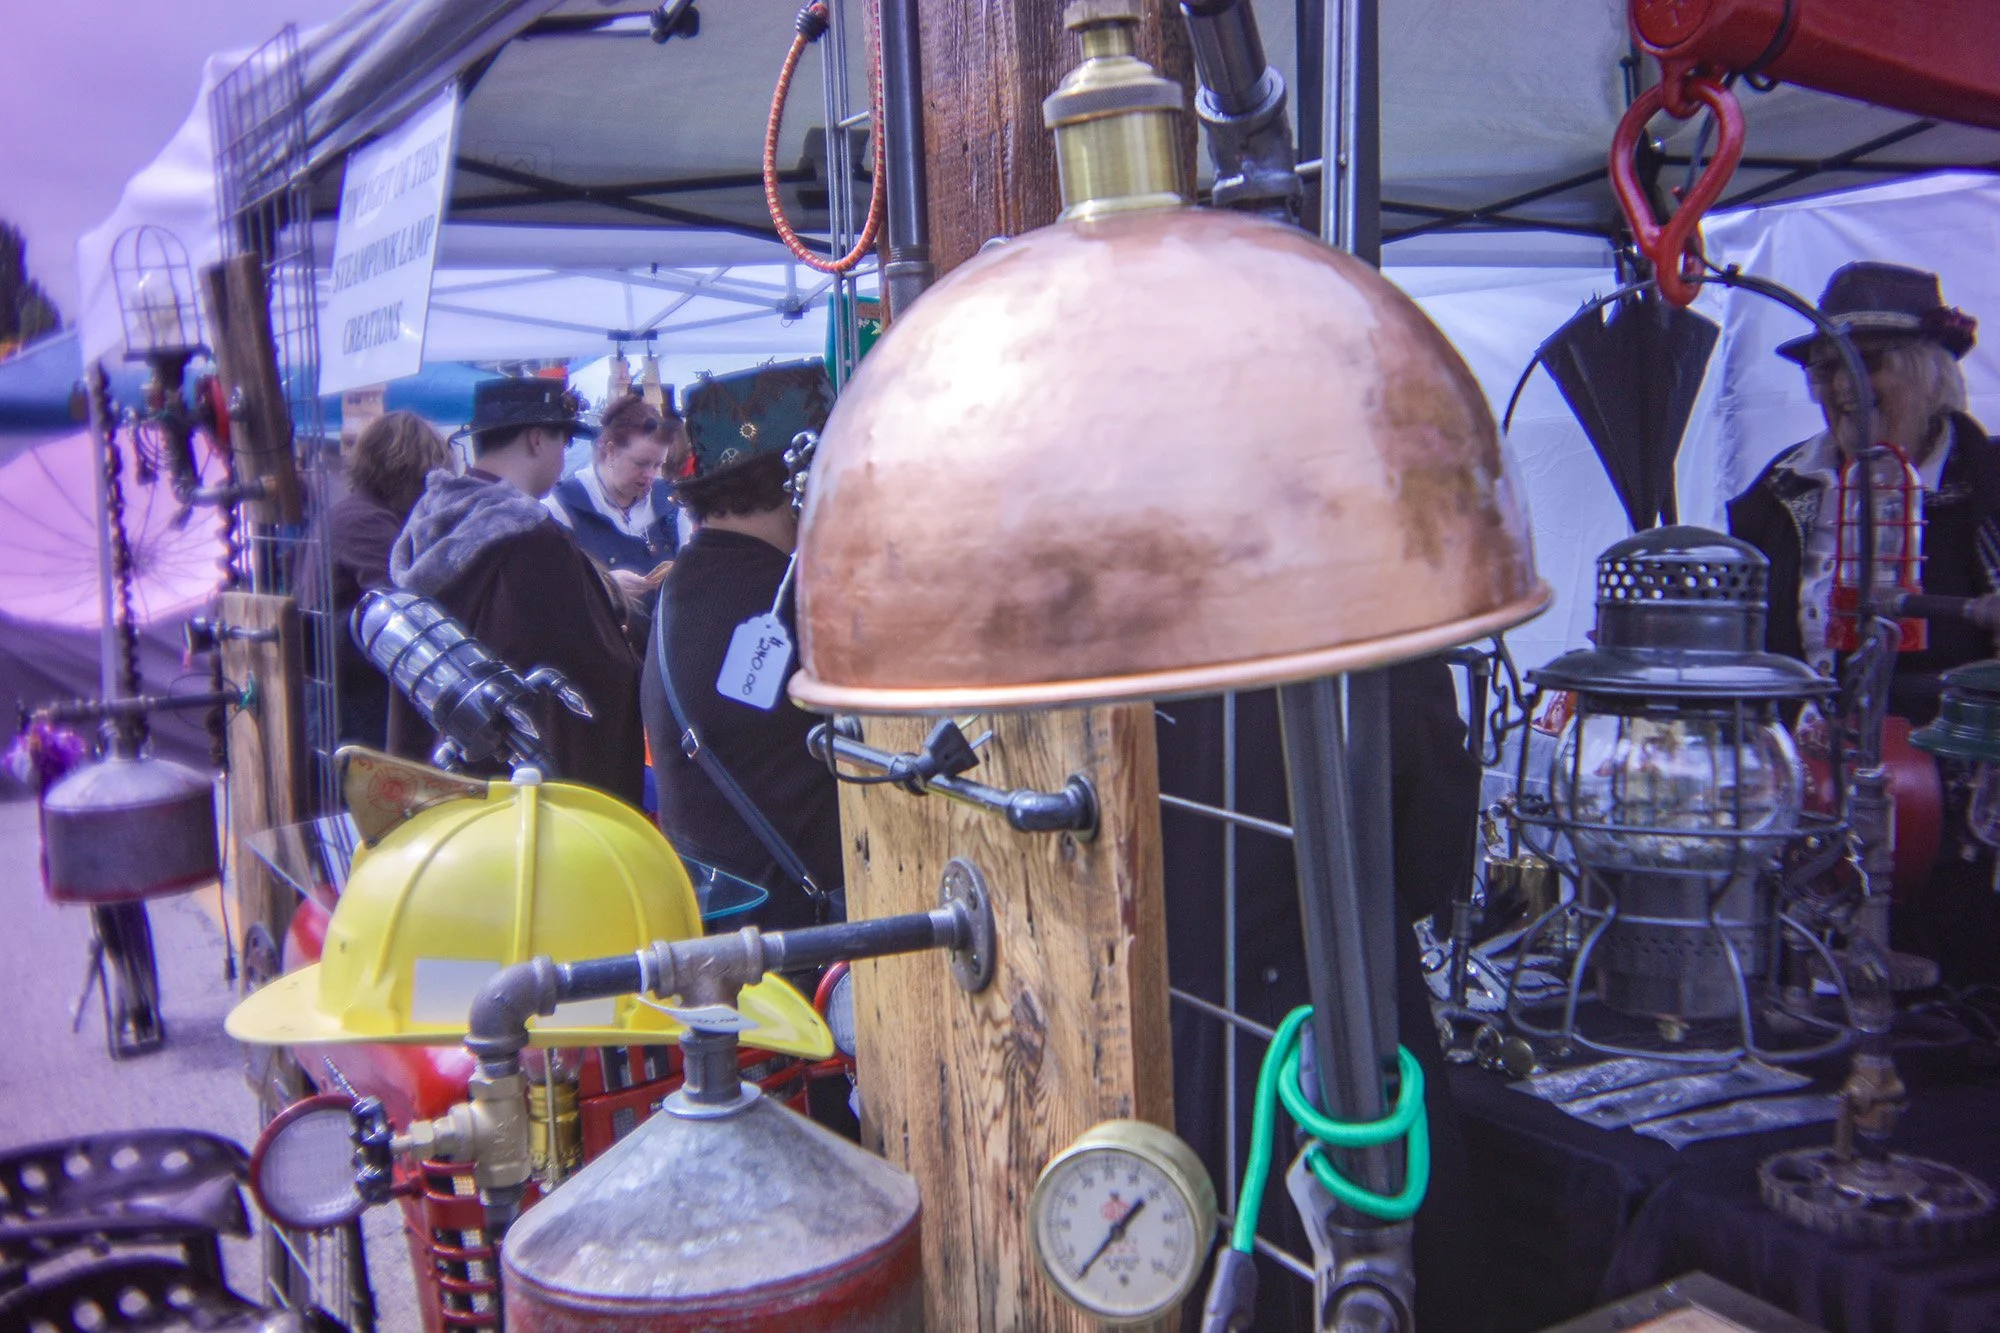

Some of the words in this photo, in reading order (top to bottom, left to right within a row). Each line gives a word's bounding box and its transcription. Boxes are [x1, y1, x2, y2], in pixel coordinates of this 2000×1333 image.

[333, 229, 401, 293] STEAMPUNK
[398, 214, 434, 266] LAMP
[343, 300, 403, 355] CREATIONS
